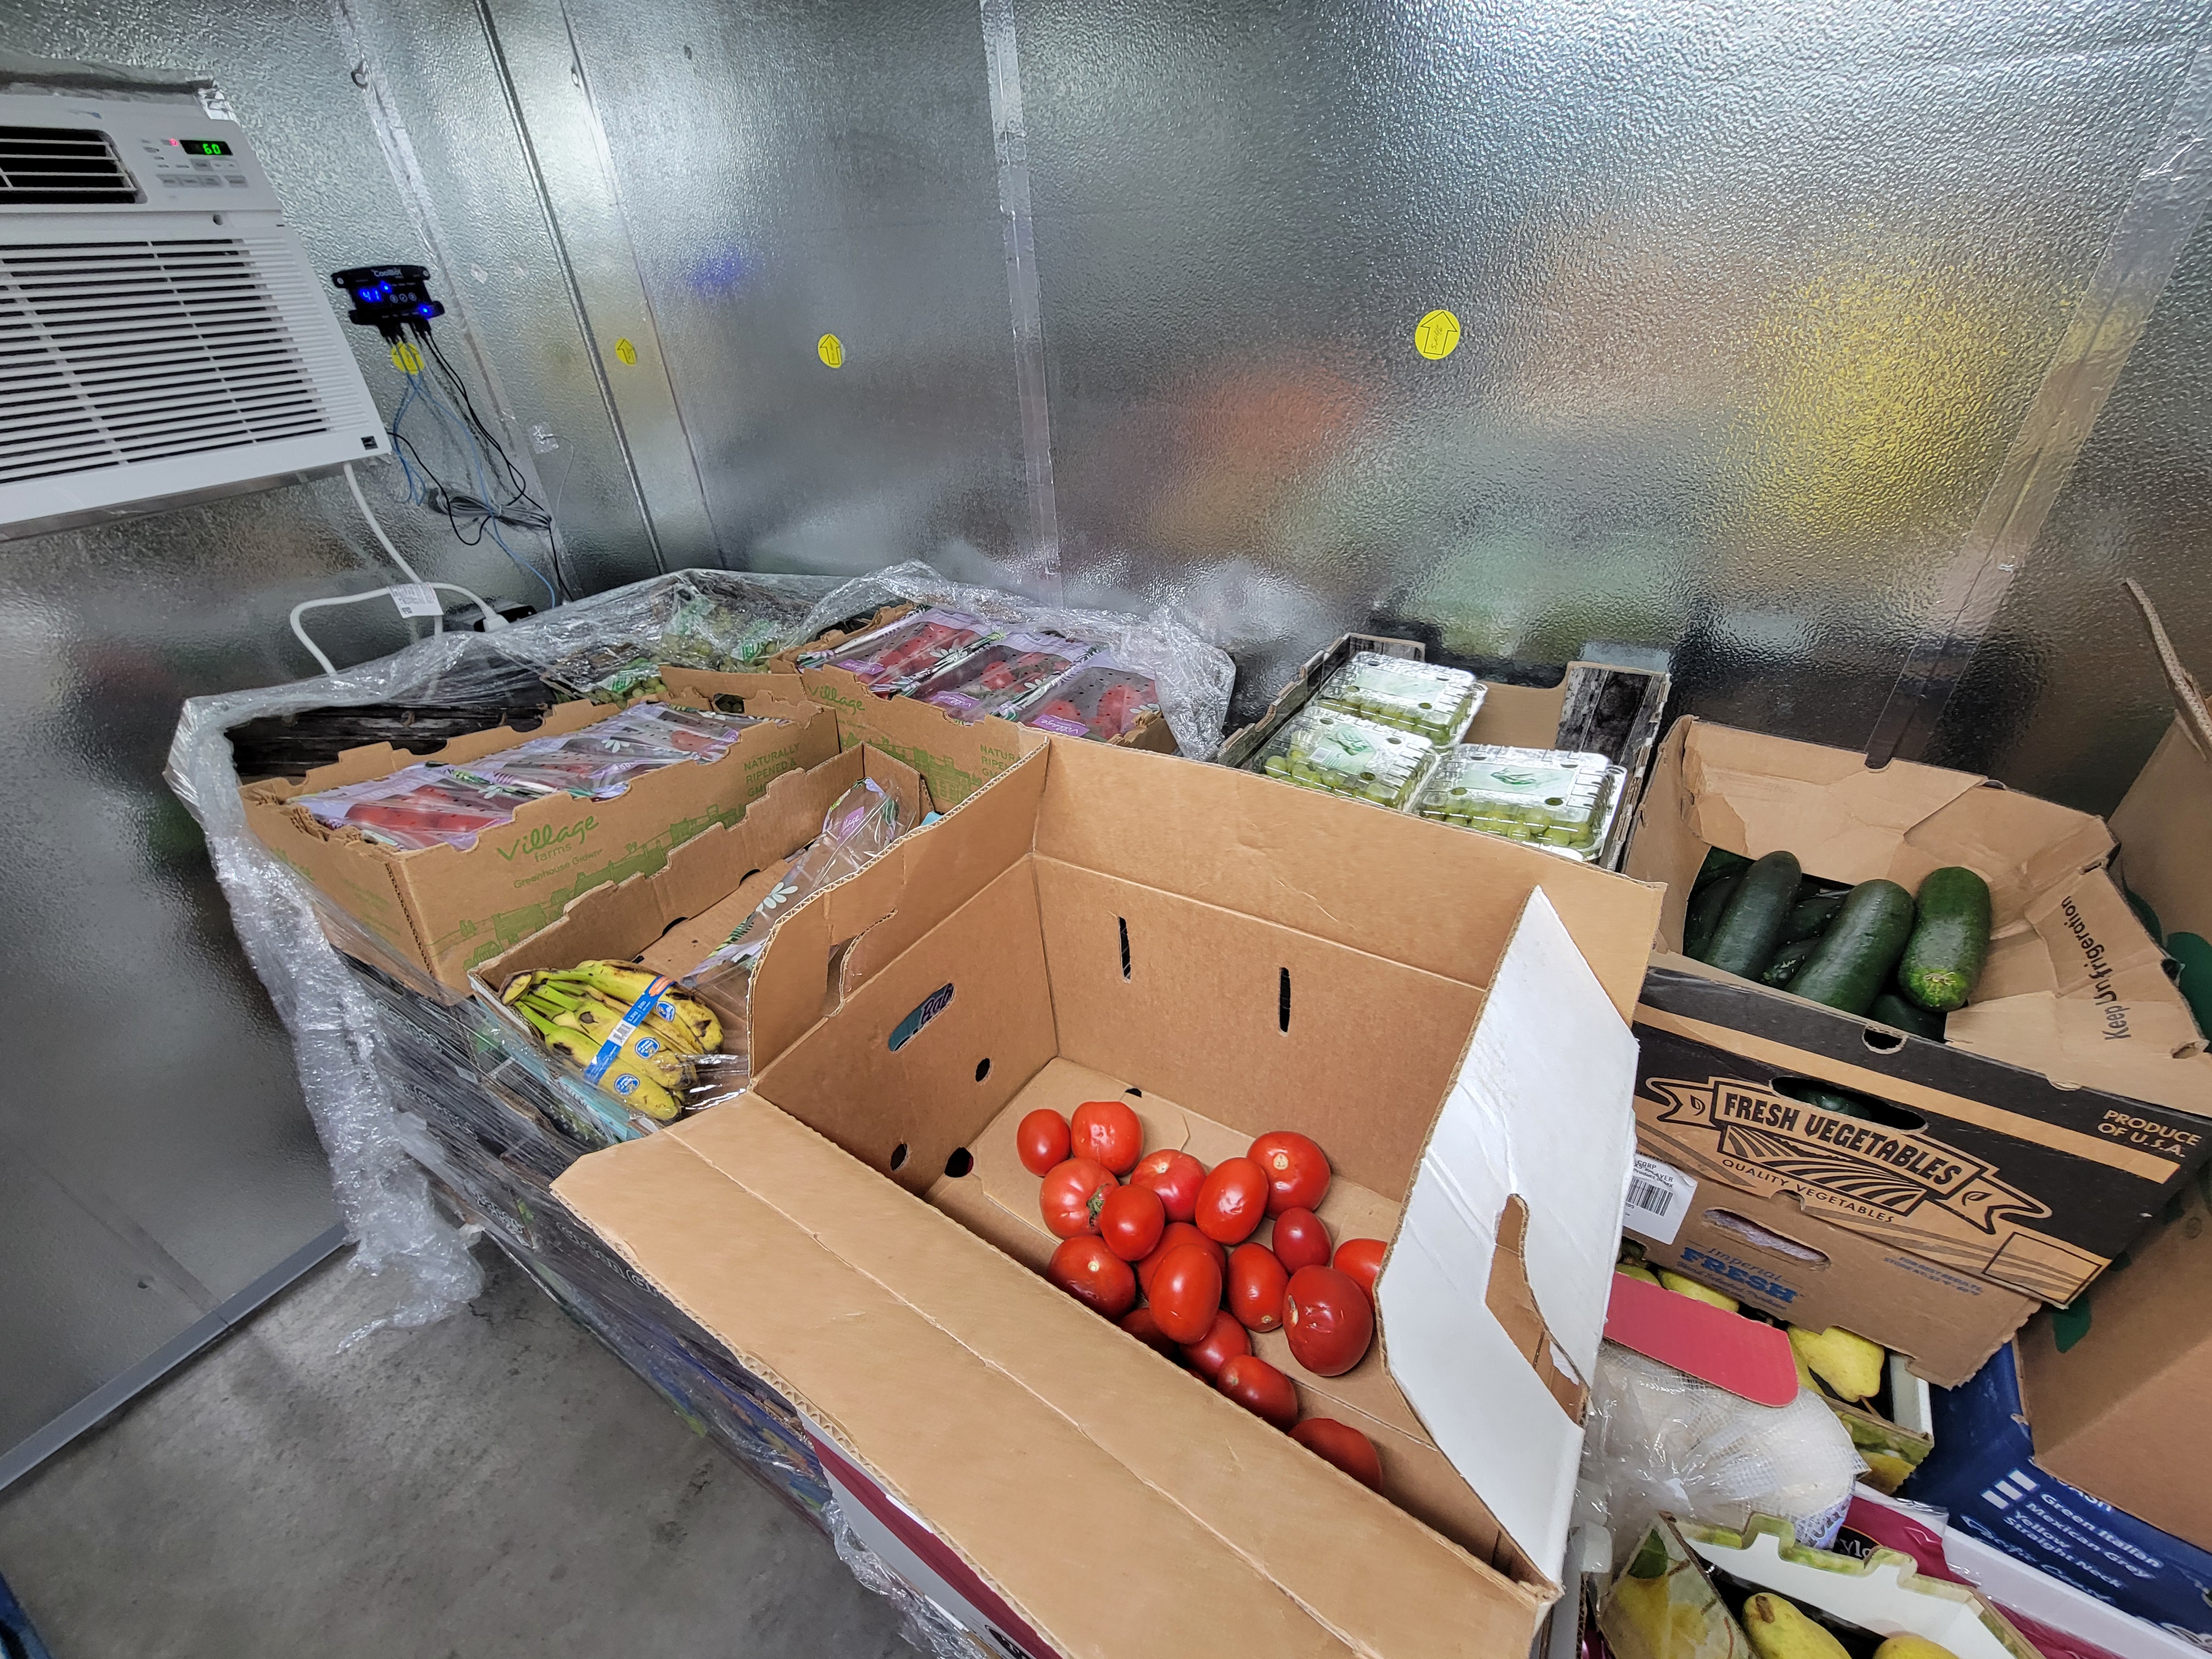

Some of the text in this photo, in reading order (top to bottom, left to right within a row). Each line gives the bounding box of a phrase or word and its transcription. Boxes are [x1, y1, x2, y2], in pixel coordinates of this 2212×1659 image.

[202, 143, 221, 155] 60
[362, 289, 380, 301] 41
[808, 684, 866, 715] Village
[1041, 719, 1079, 735] Village
[744, 742, 800, 771] NATURALLY
[746, 758, 797, 785] RIPENED &
[496, 816, 599, 861] Village
[534, 843, 572, 862] farms
[514, 862, 571, 888] Greenhouse
[2102, 1005, 2131, 1040] Keep
[1723, 1092, 1963, 1186] FRESH VEGETABLES
[2097, 1122, 2186, 1158] OF U.S.A.
[2103, 1109, 2203, 1146] PRODUCE
[1637, 1160, 1657, 1170] CORP
[1722, 1159, 1894, 1223] QUALITY VEGETABLES
[1680, 1246, 1798, 1304] FRESH
[1707, 1248, 1783, 1282] Imperial
[2013, 1511, 2070, 1549] Yellow
[2025, 1503, 2156, 1579] Mexican Grey
[2040, 1493, 2095, 1531] Green
[2098, 1530, 2164, 1568] Italian
[2002, 1516, 2126, 1588] Straight Neck
